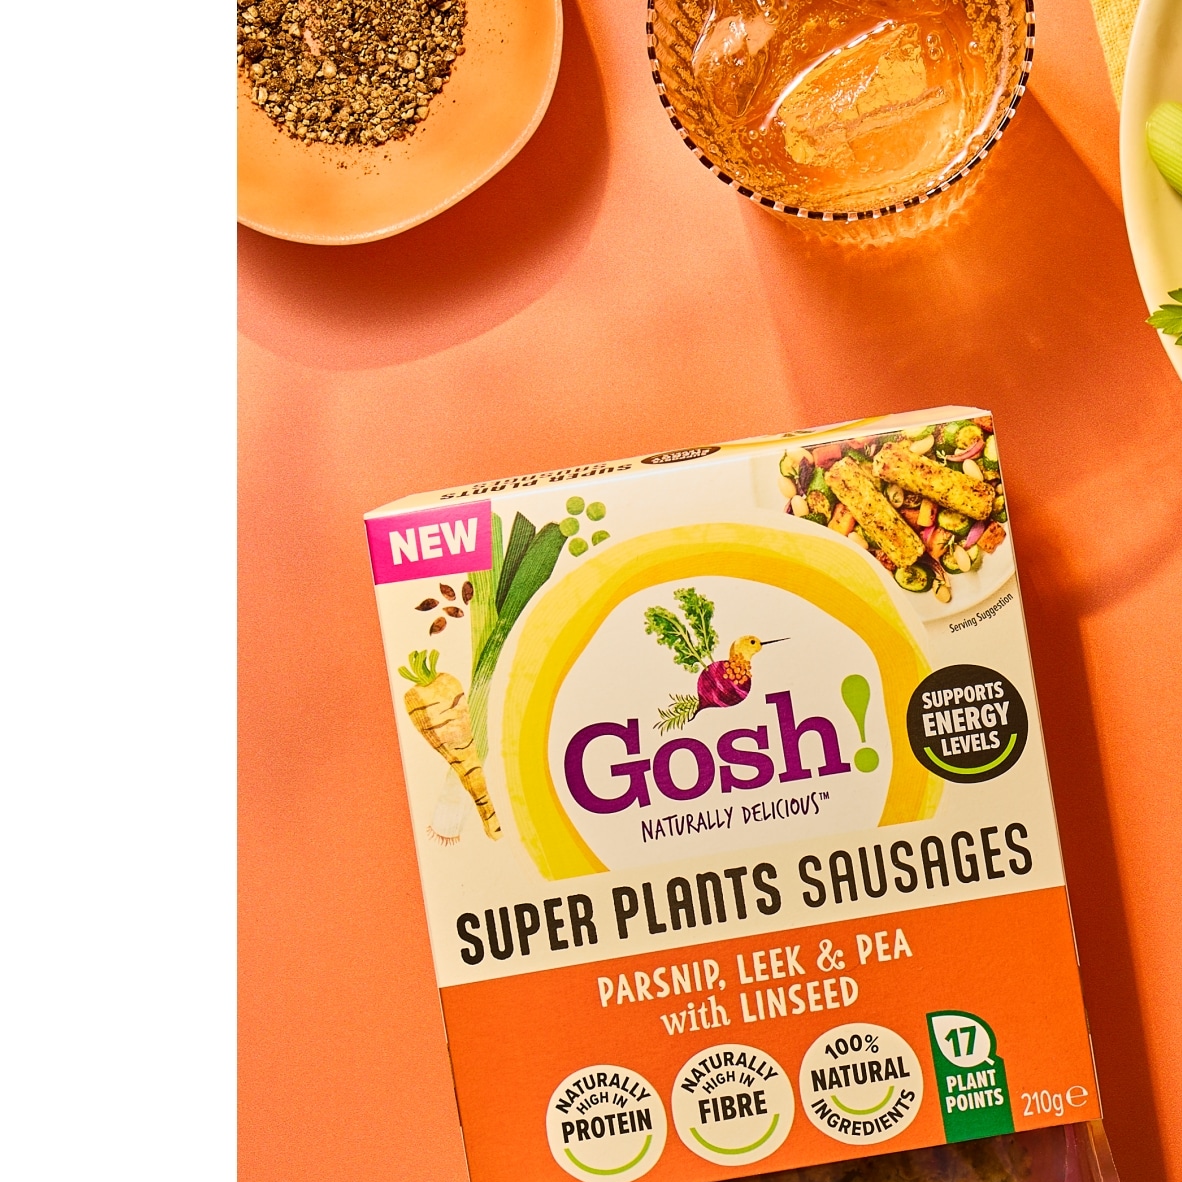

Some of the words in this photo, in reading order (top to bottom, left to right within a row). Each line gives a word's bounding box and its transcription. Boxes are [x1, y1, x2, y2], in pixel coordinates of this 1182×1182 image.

[389, 518, 478, 565] NEW
[949, 618, 978, 633] Serving
[976, 593, 1014, 622] Suggestion
[921, 681, 1005, 709] SUPPORTS
[921, 701, 1010, 738] ENERGY
[563, 673, 880, 816] Gosh!
[940, 730, 1001, 758] LEVELS
[641, 806, 733, 843] NATURALLY
[456, 893, 599, 966] SUPER
[612, 862, 783, 941] PLANTS
[799, 822, 1033, 908] SAUSAGES
[597, 960, 727, 1008] PARSNIP,
[736, 945, 806, 987] LEEK
[816, 938, 847, 973] &
[856, 928, 914, 965] PEA
[660, 994, 731, 1036] with
[741, 976, 860, 1023] LINSEED
[824, 1033, 880, 1060] 100%
[944, 1025, 977, 1058] 17
[680, 1051, 779, 1094] NATURALLY
[702, 1070, 736, 1094] HIGH
[739, 1072, 756, 1088] IN
[810, 1056, 911, 1092] NATURAL
[946, 1069, 997, 1093] PLANT
[555, 1072, 651, 1115] NATURALLY
[576, 1091, 609, 1116] HIGH
[612, 1093, 629, 1109] IN
[698, 1089, 768, 1125] FIBRE
[810, 1088, 916, 1136] INGREDIENTS
[945, 1088, 1005, 1113] POINTS
[561, 1107, 653, 1144] PROTEIN
